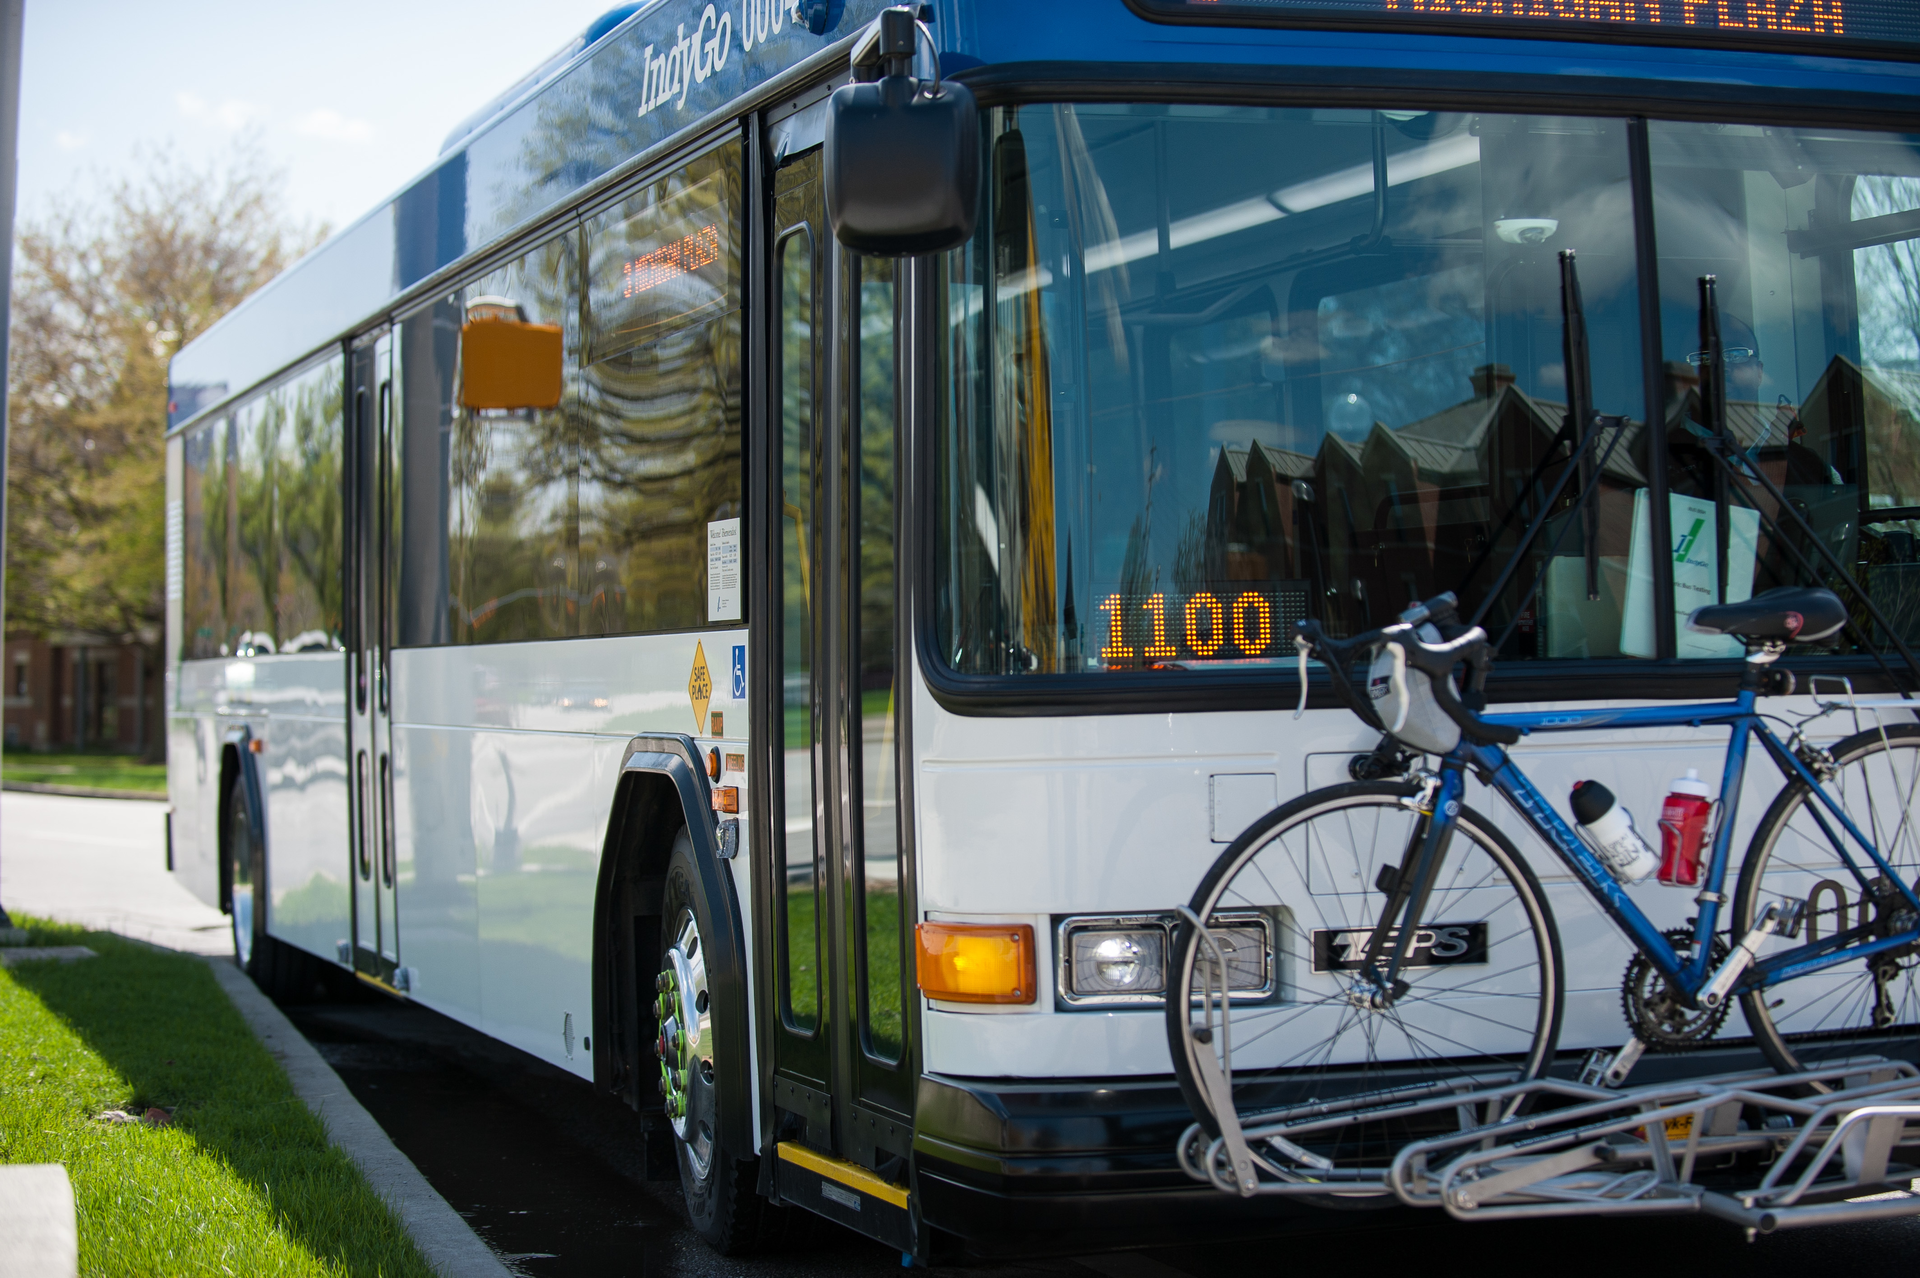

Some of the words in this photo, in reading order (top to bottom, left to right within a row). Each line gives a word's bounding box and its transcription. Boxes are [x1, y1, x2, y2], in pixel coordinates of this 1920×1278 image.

[638, 3, 732, 118] IndyGo
[684, 222, 718, 275] PLAZA
[1099, 592, 1271, 658] 1100
[694, 666, 706, 682] SAFE
[691, 683, 708, 701] PLACE
[711, 716, 722, 734] RAMP
